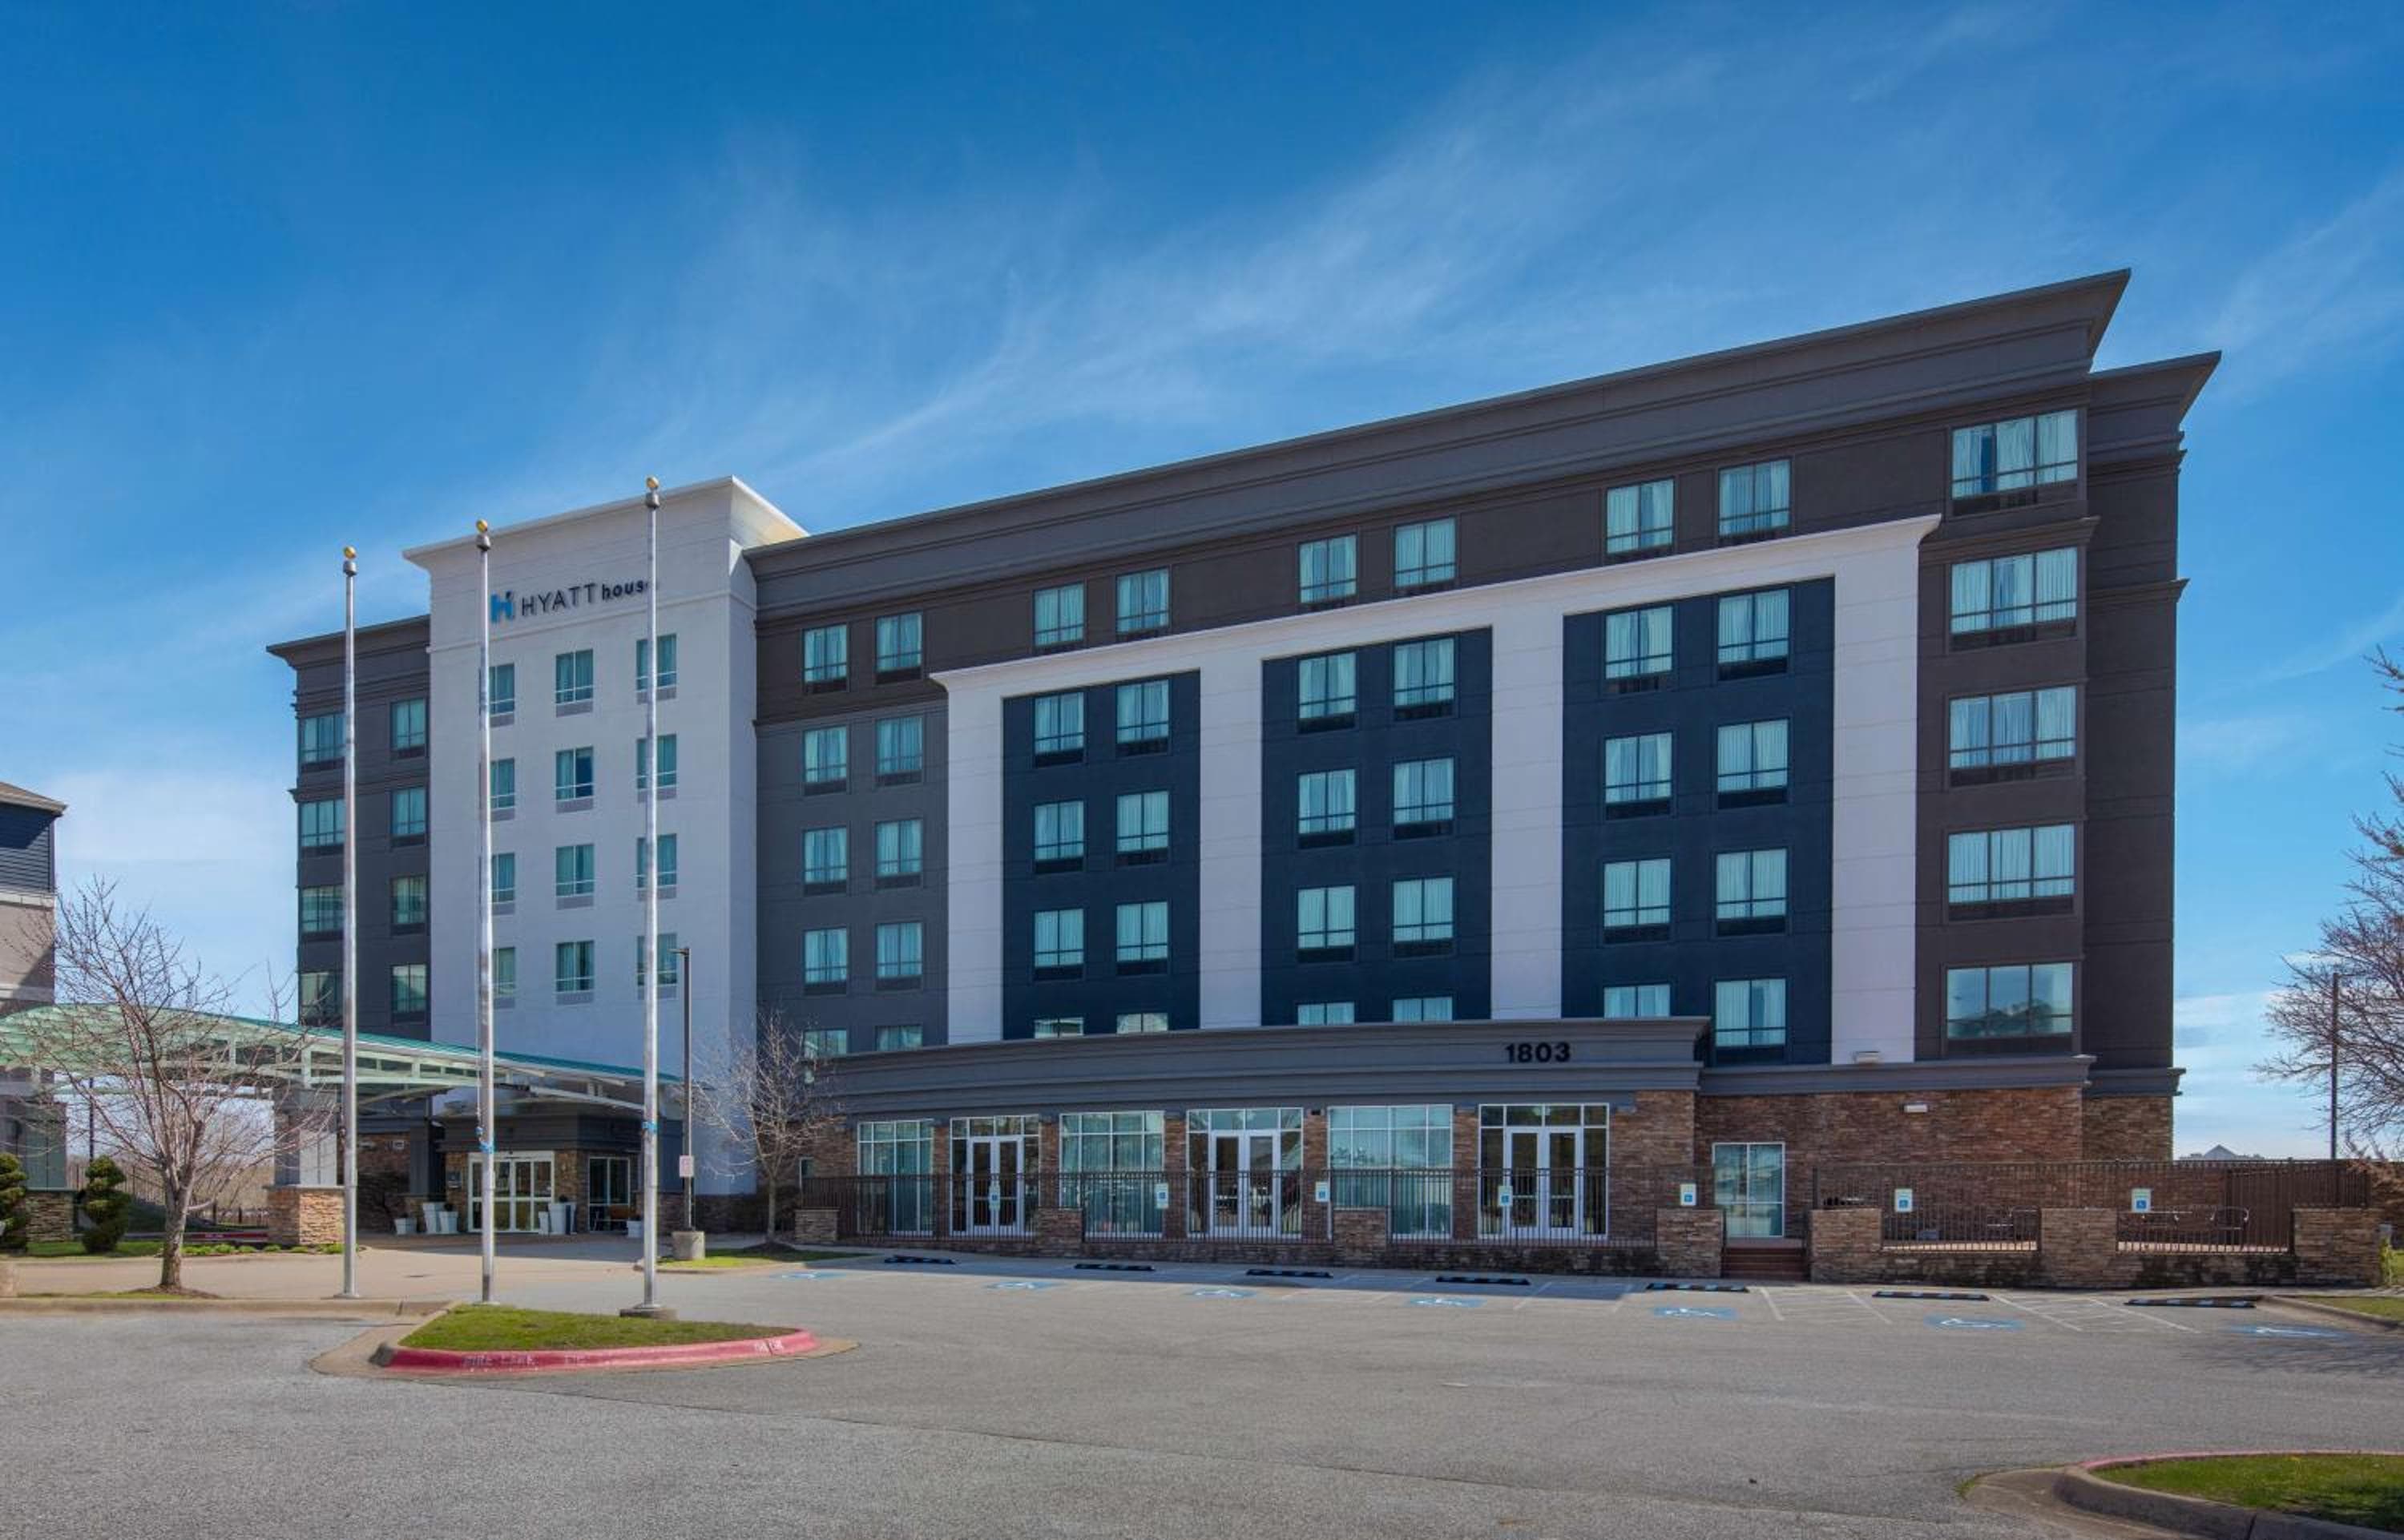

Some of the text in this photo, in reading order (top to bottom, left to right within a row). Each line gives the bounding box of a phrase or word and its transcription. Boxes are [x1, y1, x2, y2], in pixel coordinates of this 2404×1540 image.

[522, 583, 595, 616] HYATT
[602, 580, 648, 600] hous
[1505, 1042, 1571, 1064] 1803
